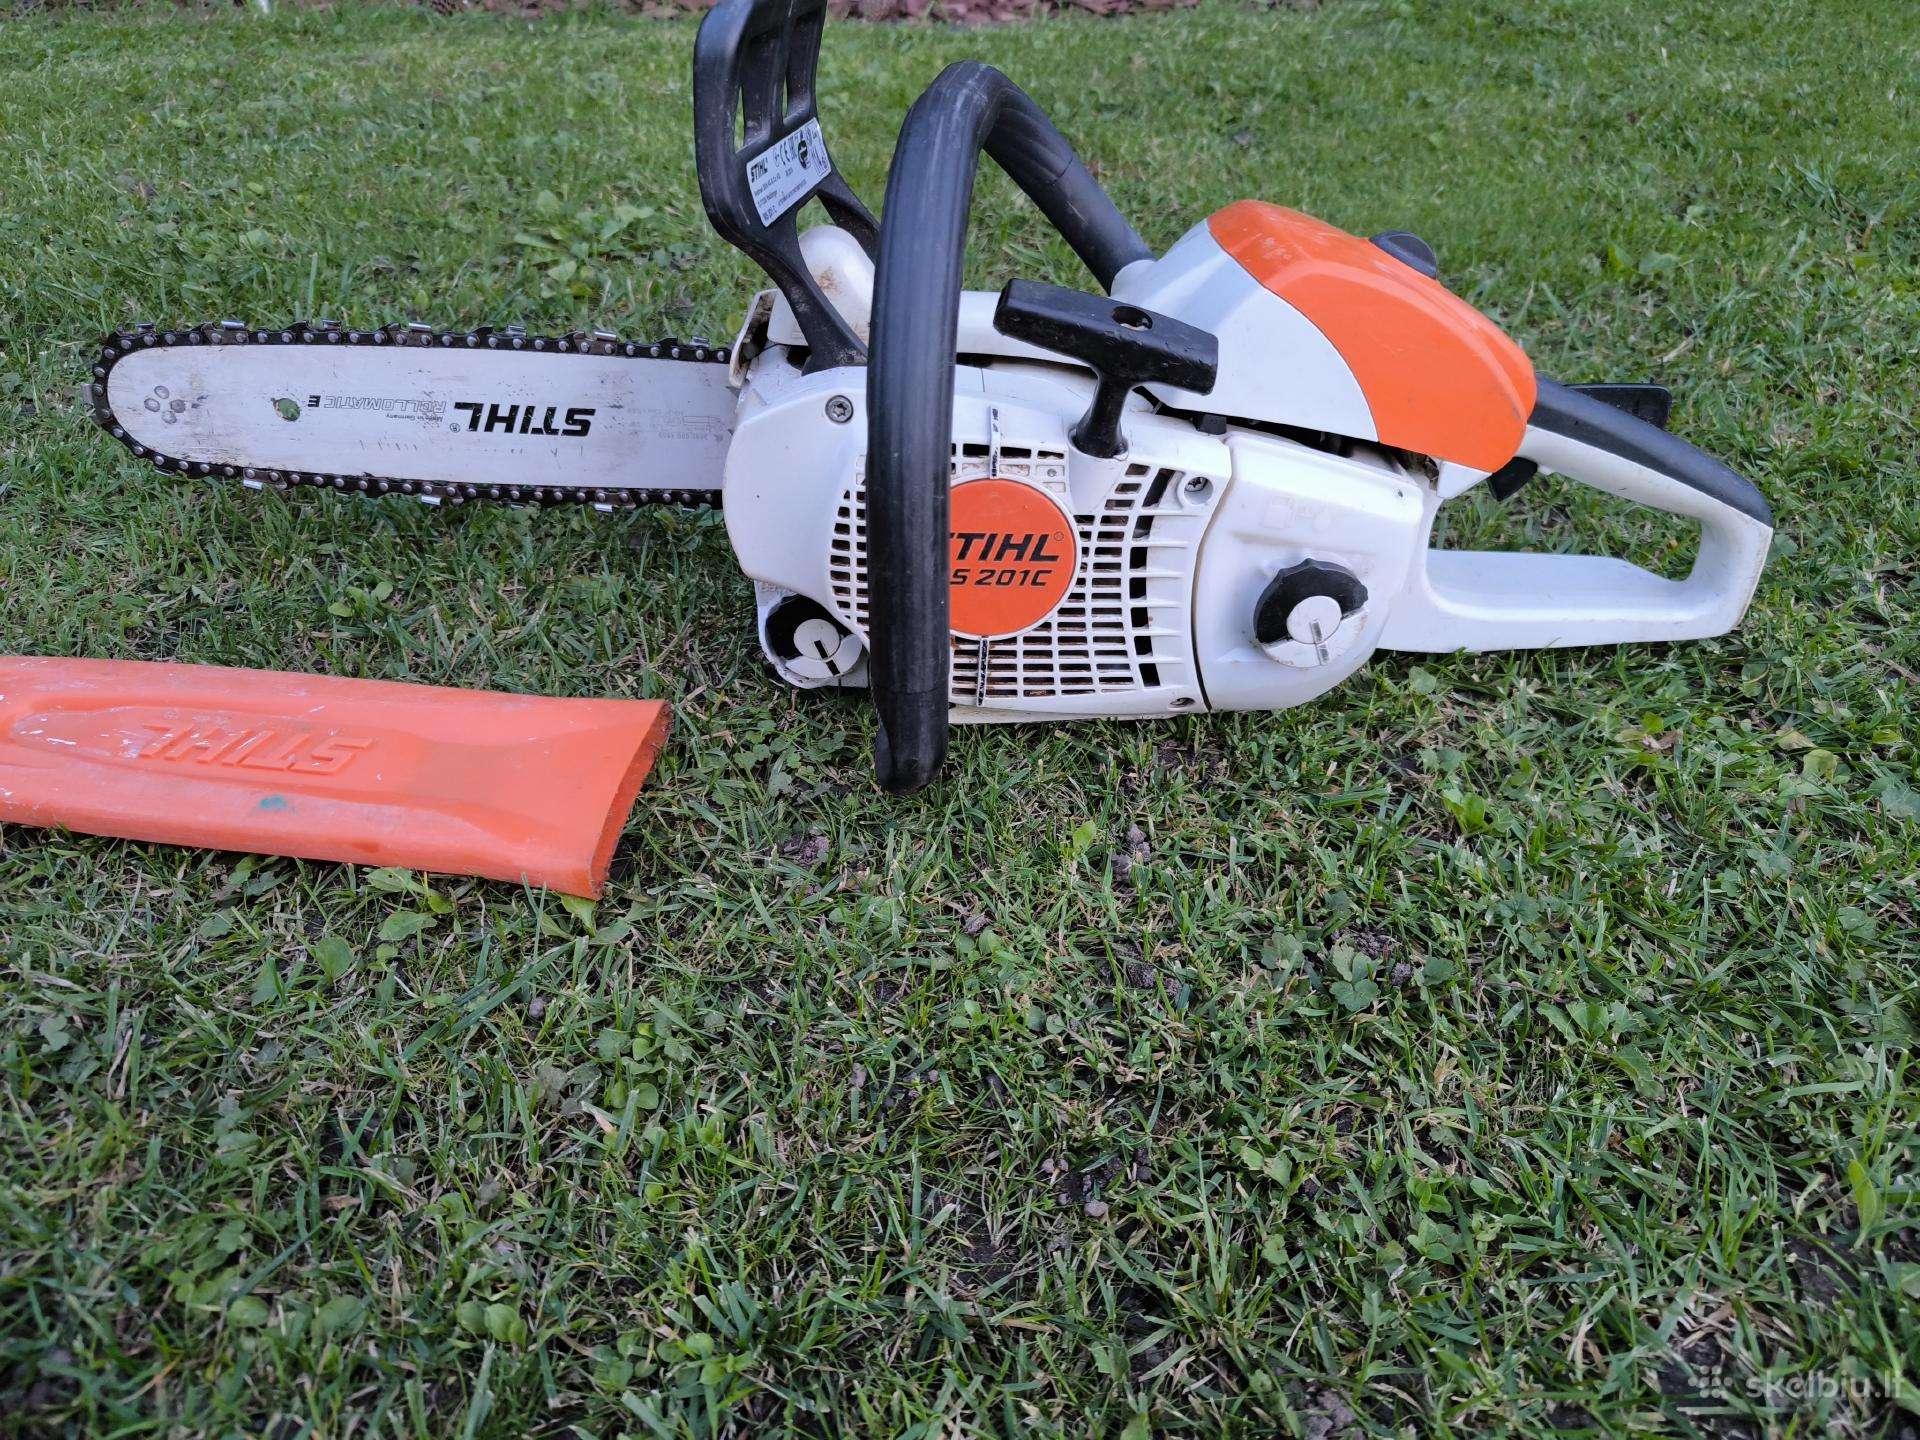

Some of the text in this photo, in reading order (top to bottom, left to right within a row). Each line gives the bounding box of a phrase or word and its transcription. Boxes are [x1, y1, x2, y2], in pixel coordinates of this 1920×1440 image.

[751, 161, 768, 183] STIHL
[308, 395, 446, 414] ROLLOMATIC E
[386, 413, 415, 421] Germany
[454, 402, 596, 436] STIHL
[950, 532, 1059, 562] TIHL
[949, 568, 1053, 587] S 201C
[139, 723, 378, 775] STIHL
